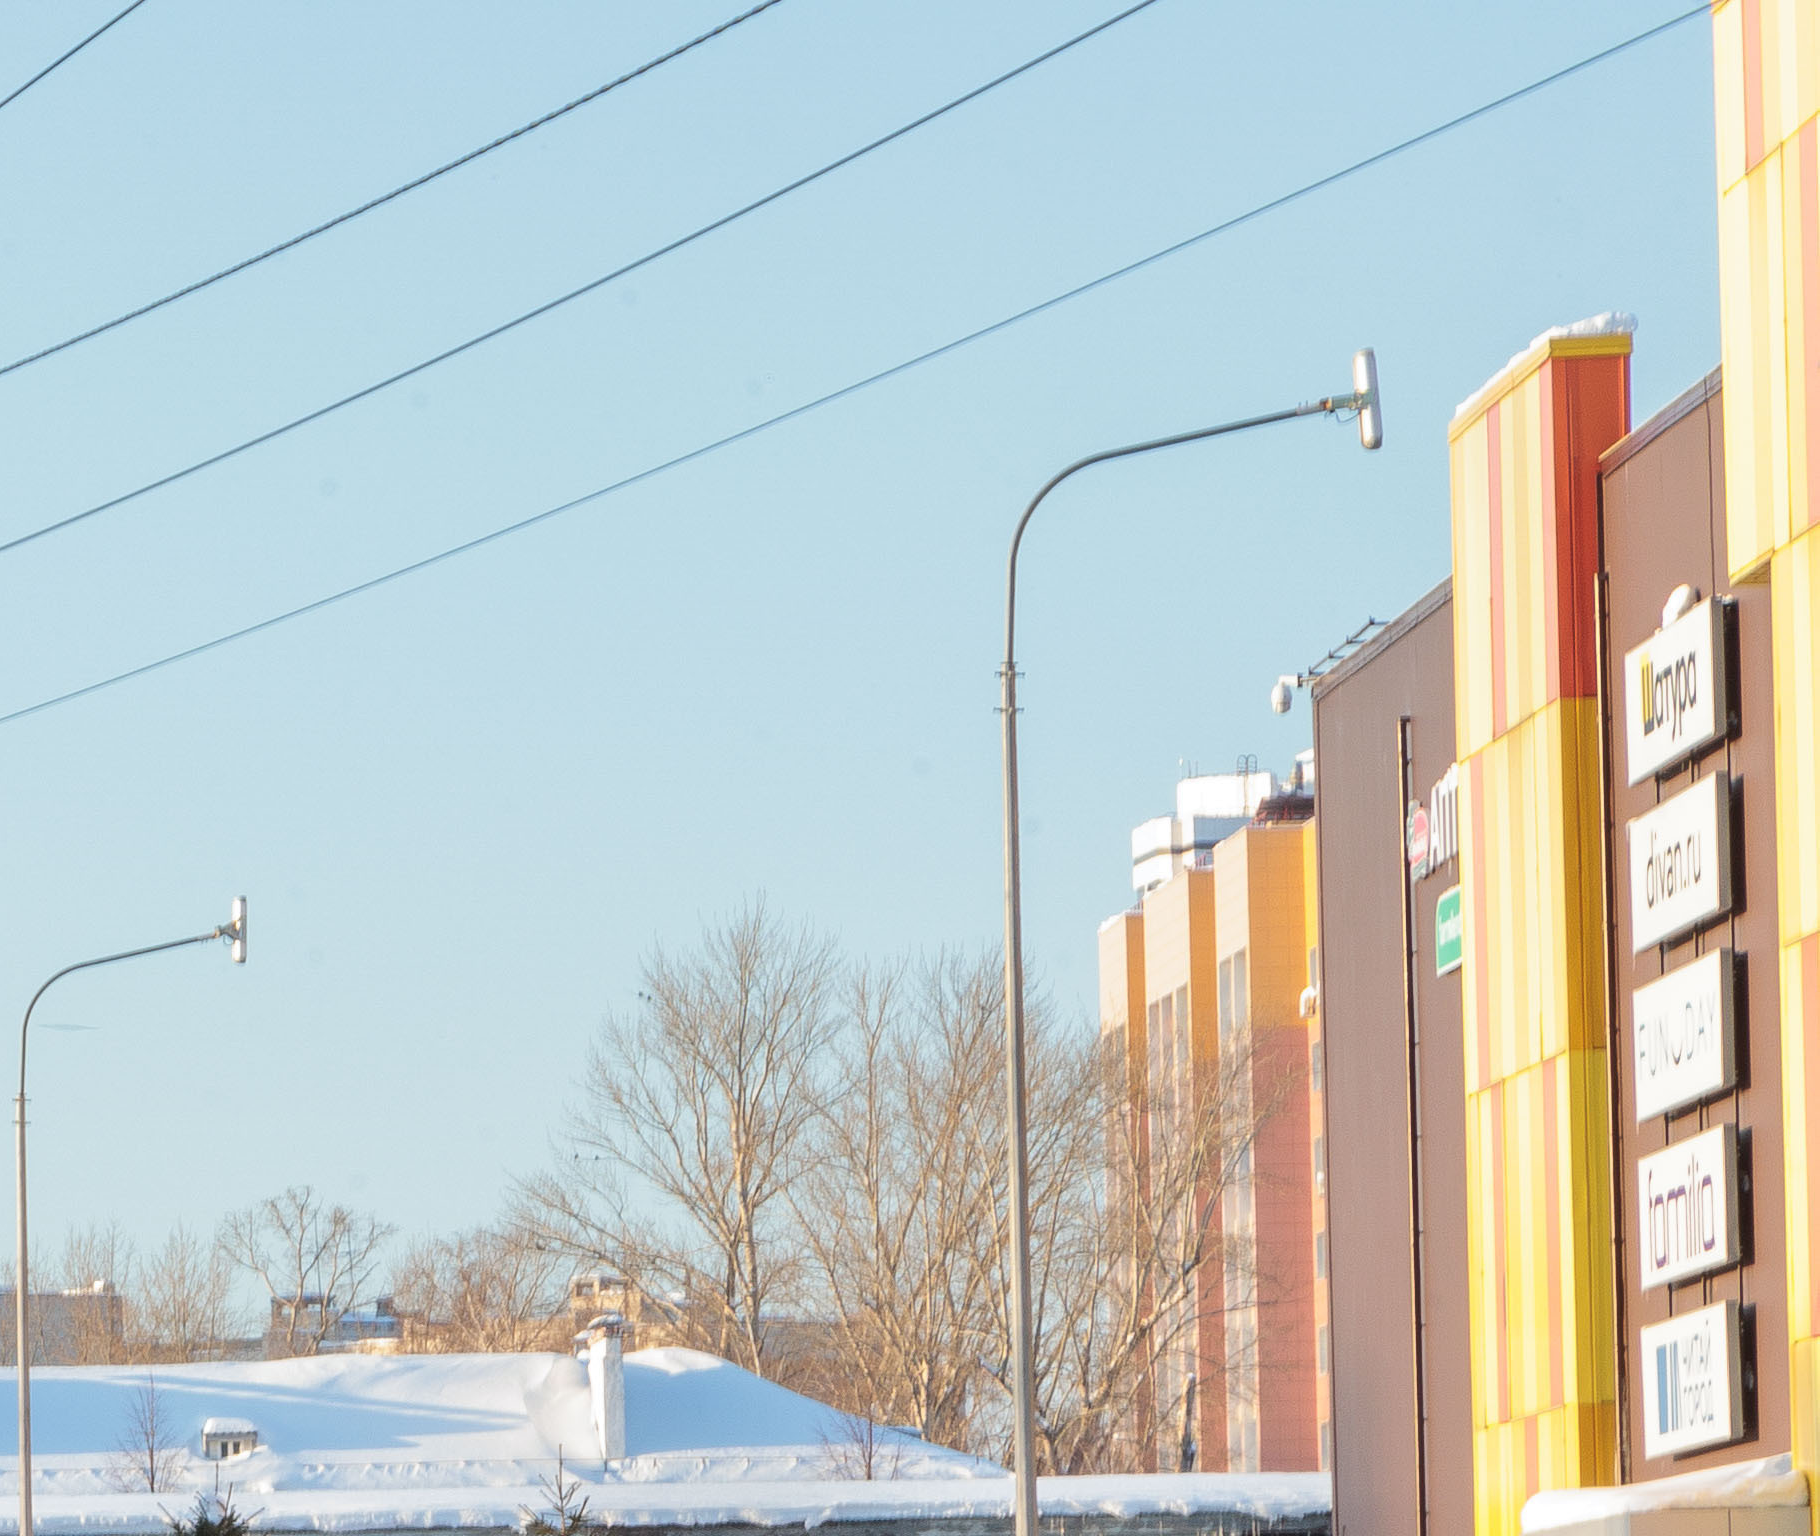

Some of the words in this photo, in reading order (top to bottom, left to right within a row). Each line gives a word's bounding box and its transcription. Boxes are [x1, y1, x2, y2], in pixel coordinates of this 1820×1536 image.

[1640, 651, 1697, 742] Шатура
[1646, 828, 1701, 909] divan.ru
[1649, 1153, 1715, 1272] familia
